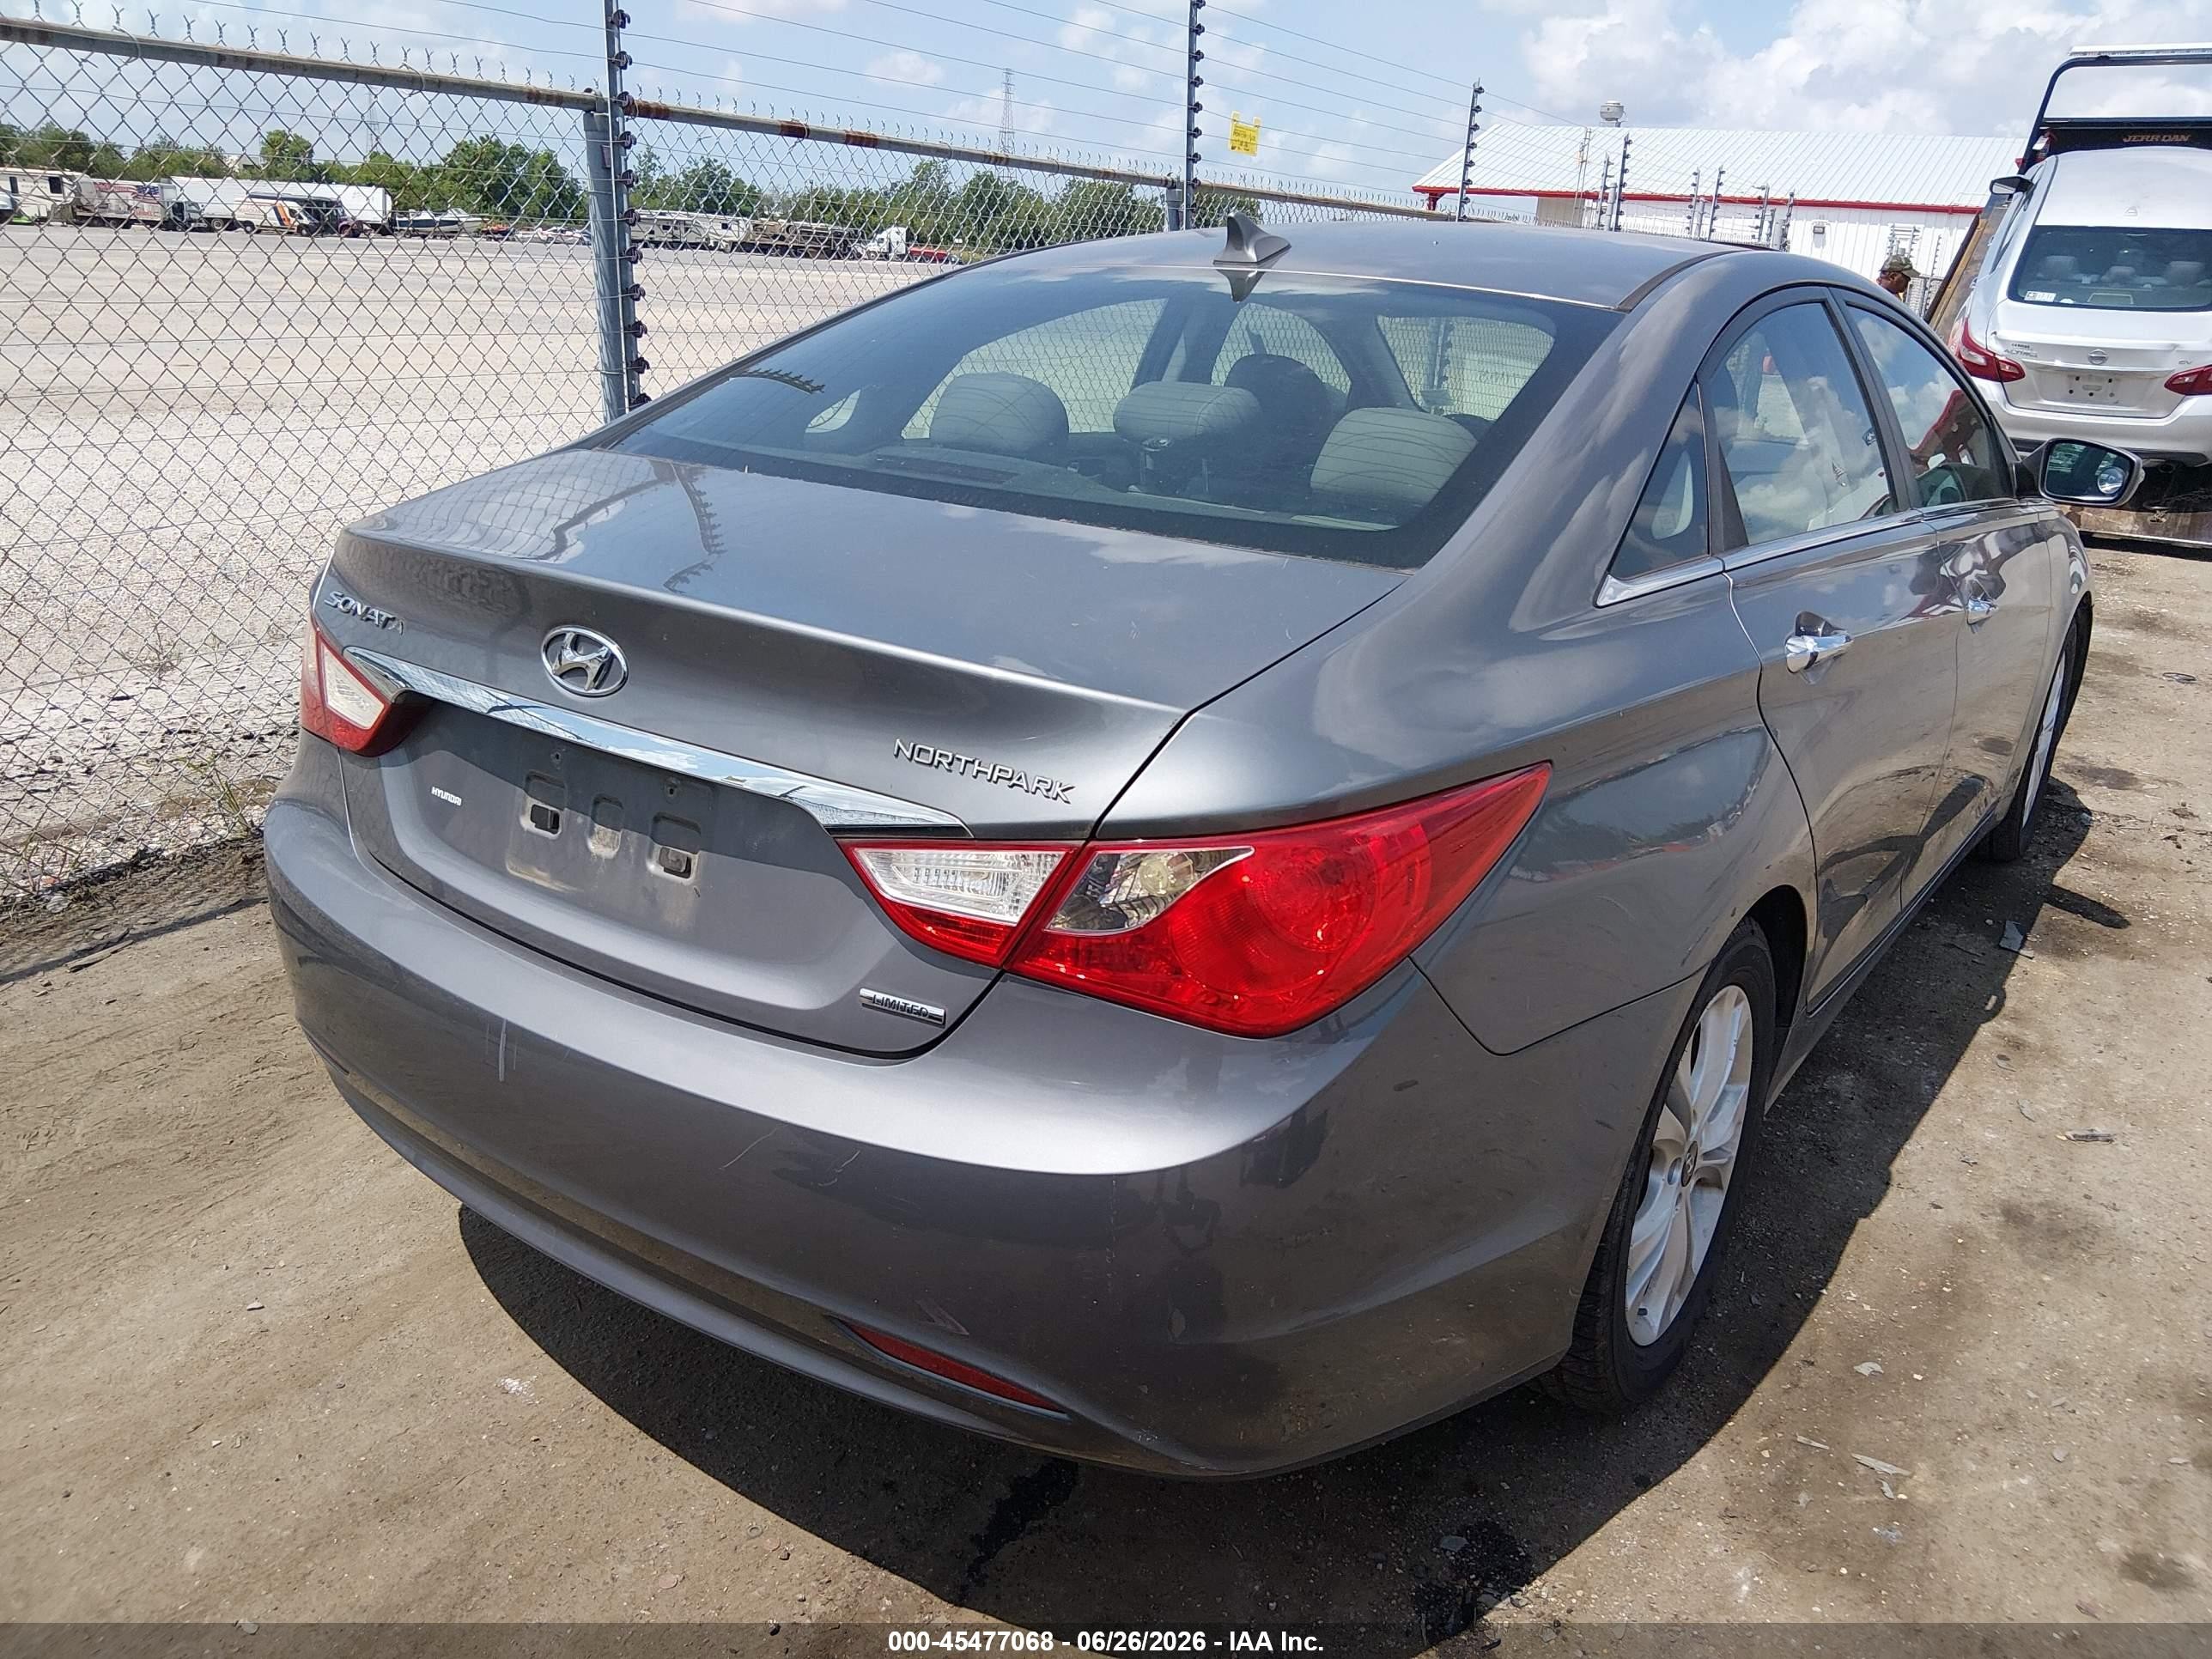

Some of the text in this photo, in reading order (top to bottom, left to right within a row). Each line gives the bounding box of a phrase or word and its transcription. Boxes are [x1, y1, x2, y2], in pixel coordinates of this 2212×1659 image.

[893, 738, 1075, 804] NORTHPARK
[431, 786, 462, 806] HYUNDAI
[872, 994, 930, 1018] LIMITED
